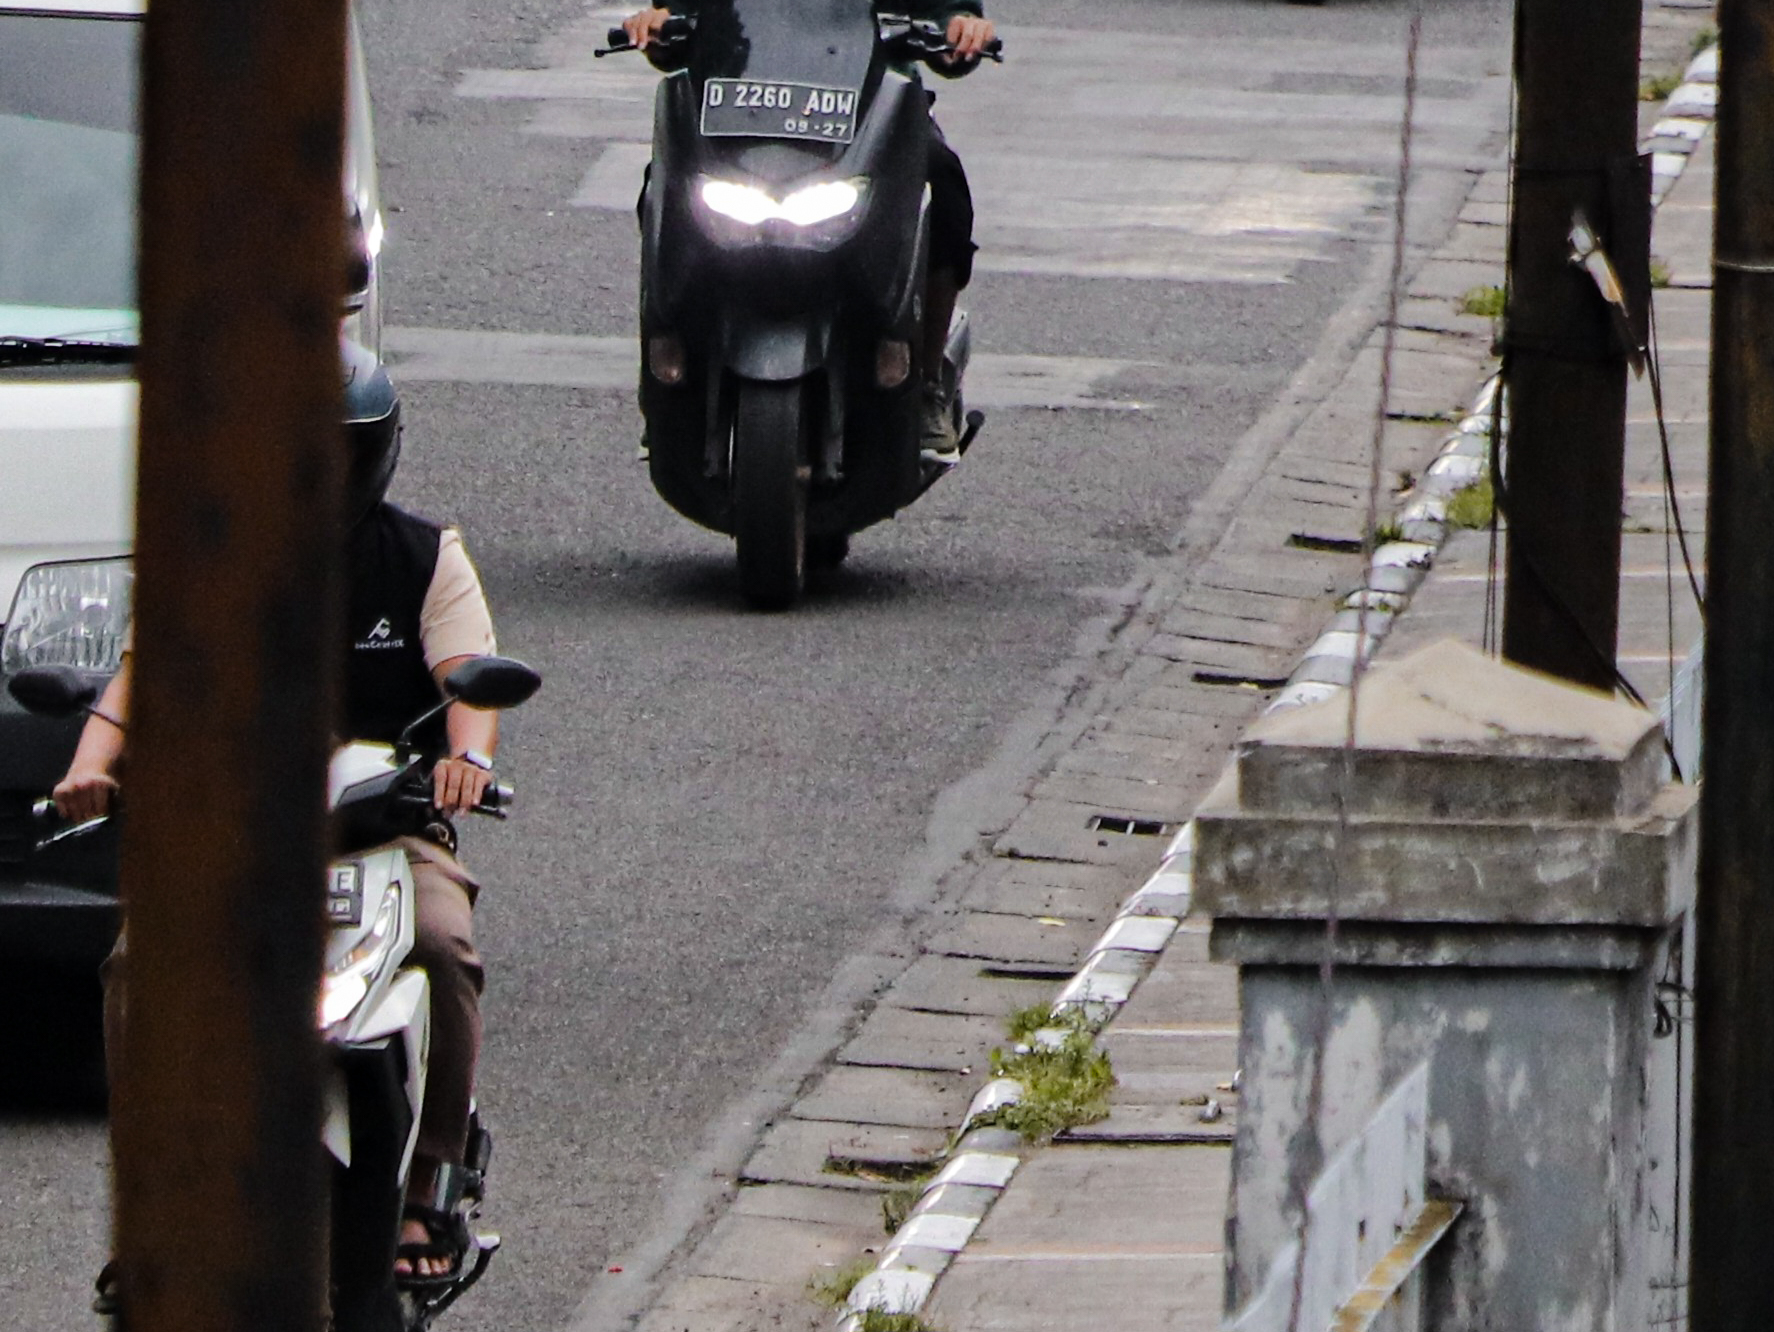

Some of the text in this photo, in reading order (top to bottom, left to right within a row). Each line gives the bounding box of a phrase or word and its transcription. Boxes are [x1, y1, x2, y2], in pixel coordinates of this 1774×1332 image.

[708, 84, 853, 115] D 2260 ADW
